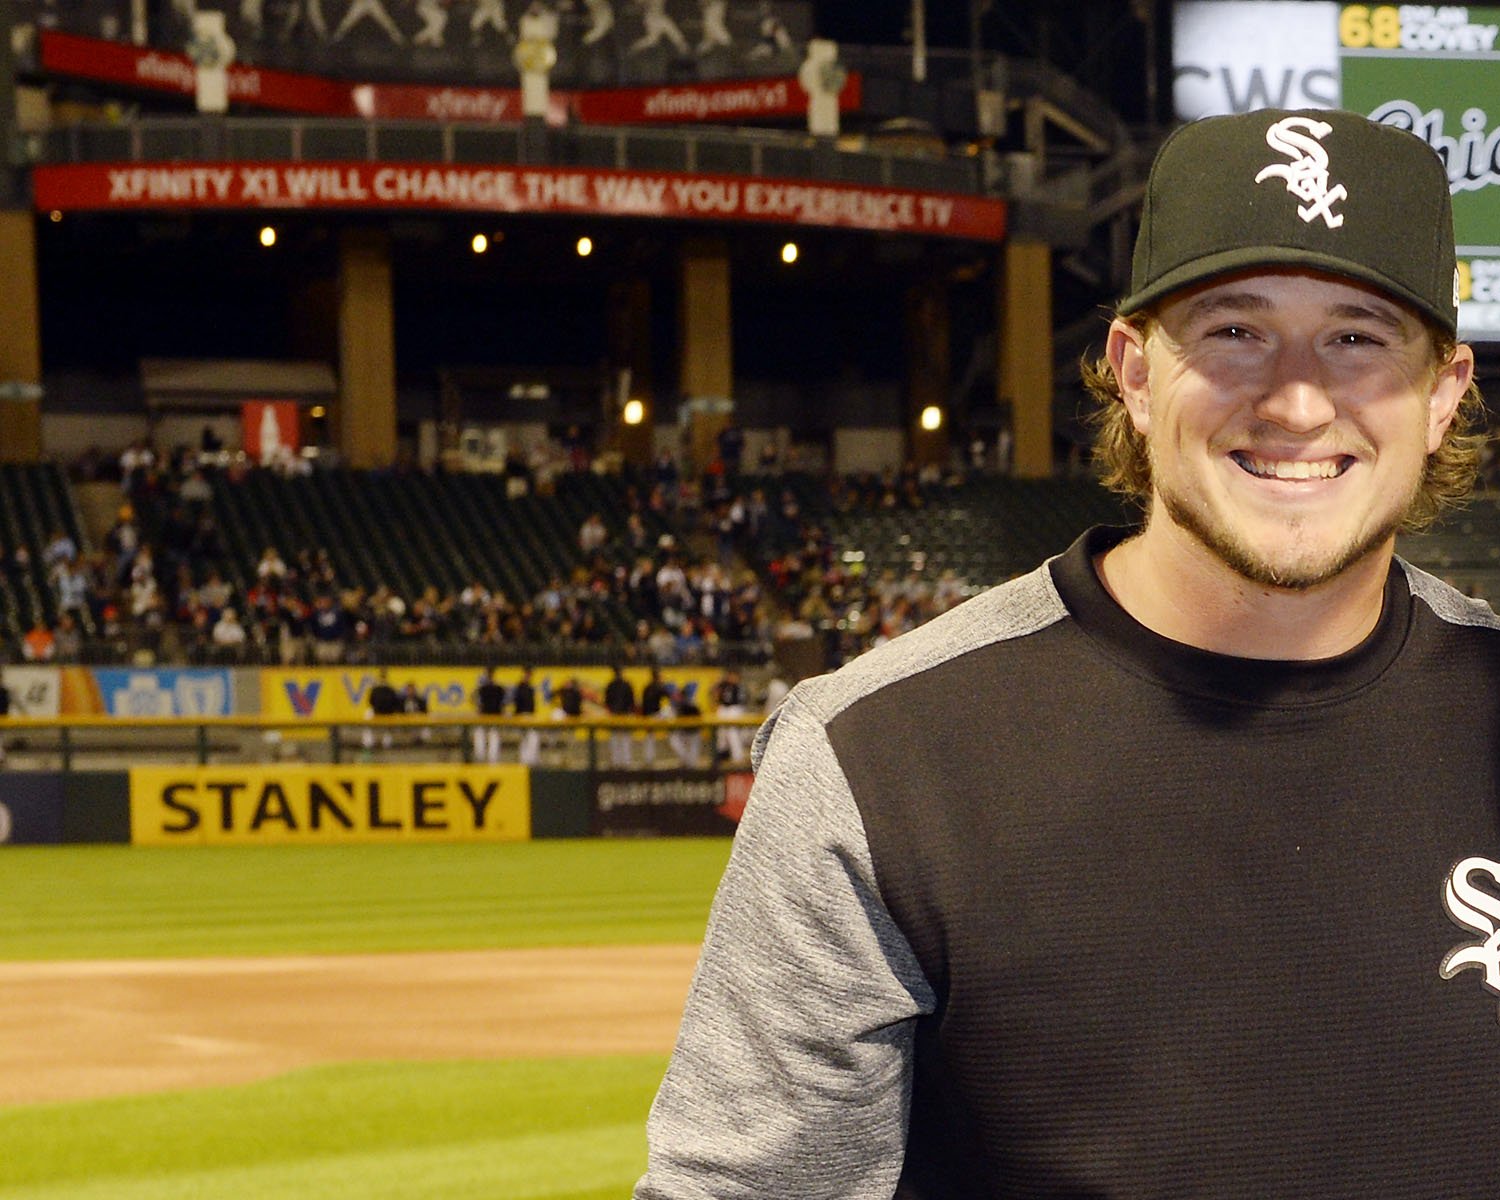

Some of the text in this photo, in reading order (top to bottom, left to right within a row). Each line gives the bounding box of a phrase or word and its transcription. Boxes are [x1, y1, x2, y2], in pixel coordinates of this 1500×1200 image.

[1339, 5, 1400, 49] 68
[1400, 24, 1498, 50] COVEY
[108, 168, 953, 227] XFINITY X1 WILL CHANGE THE WAY YOU EXPERIENCE TV
[160, 781, 501, 834] STANLEY
